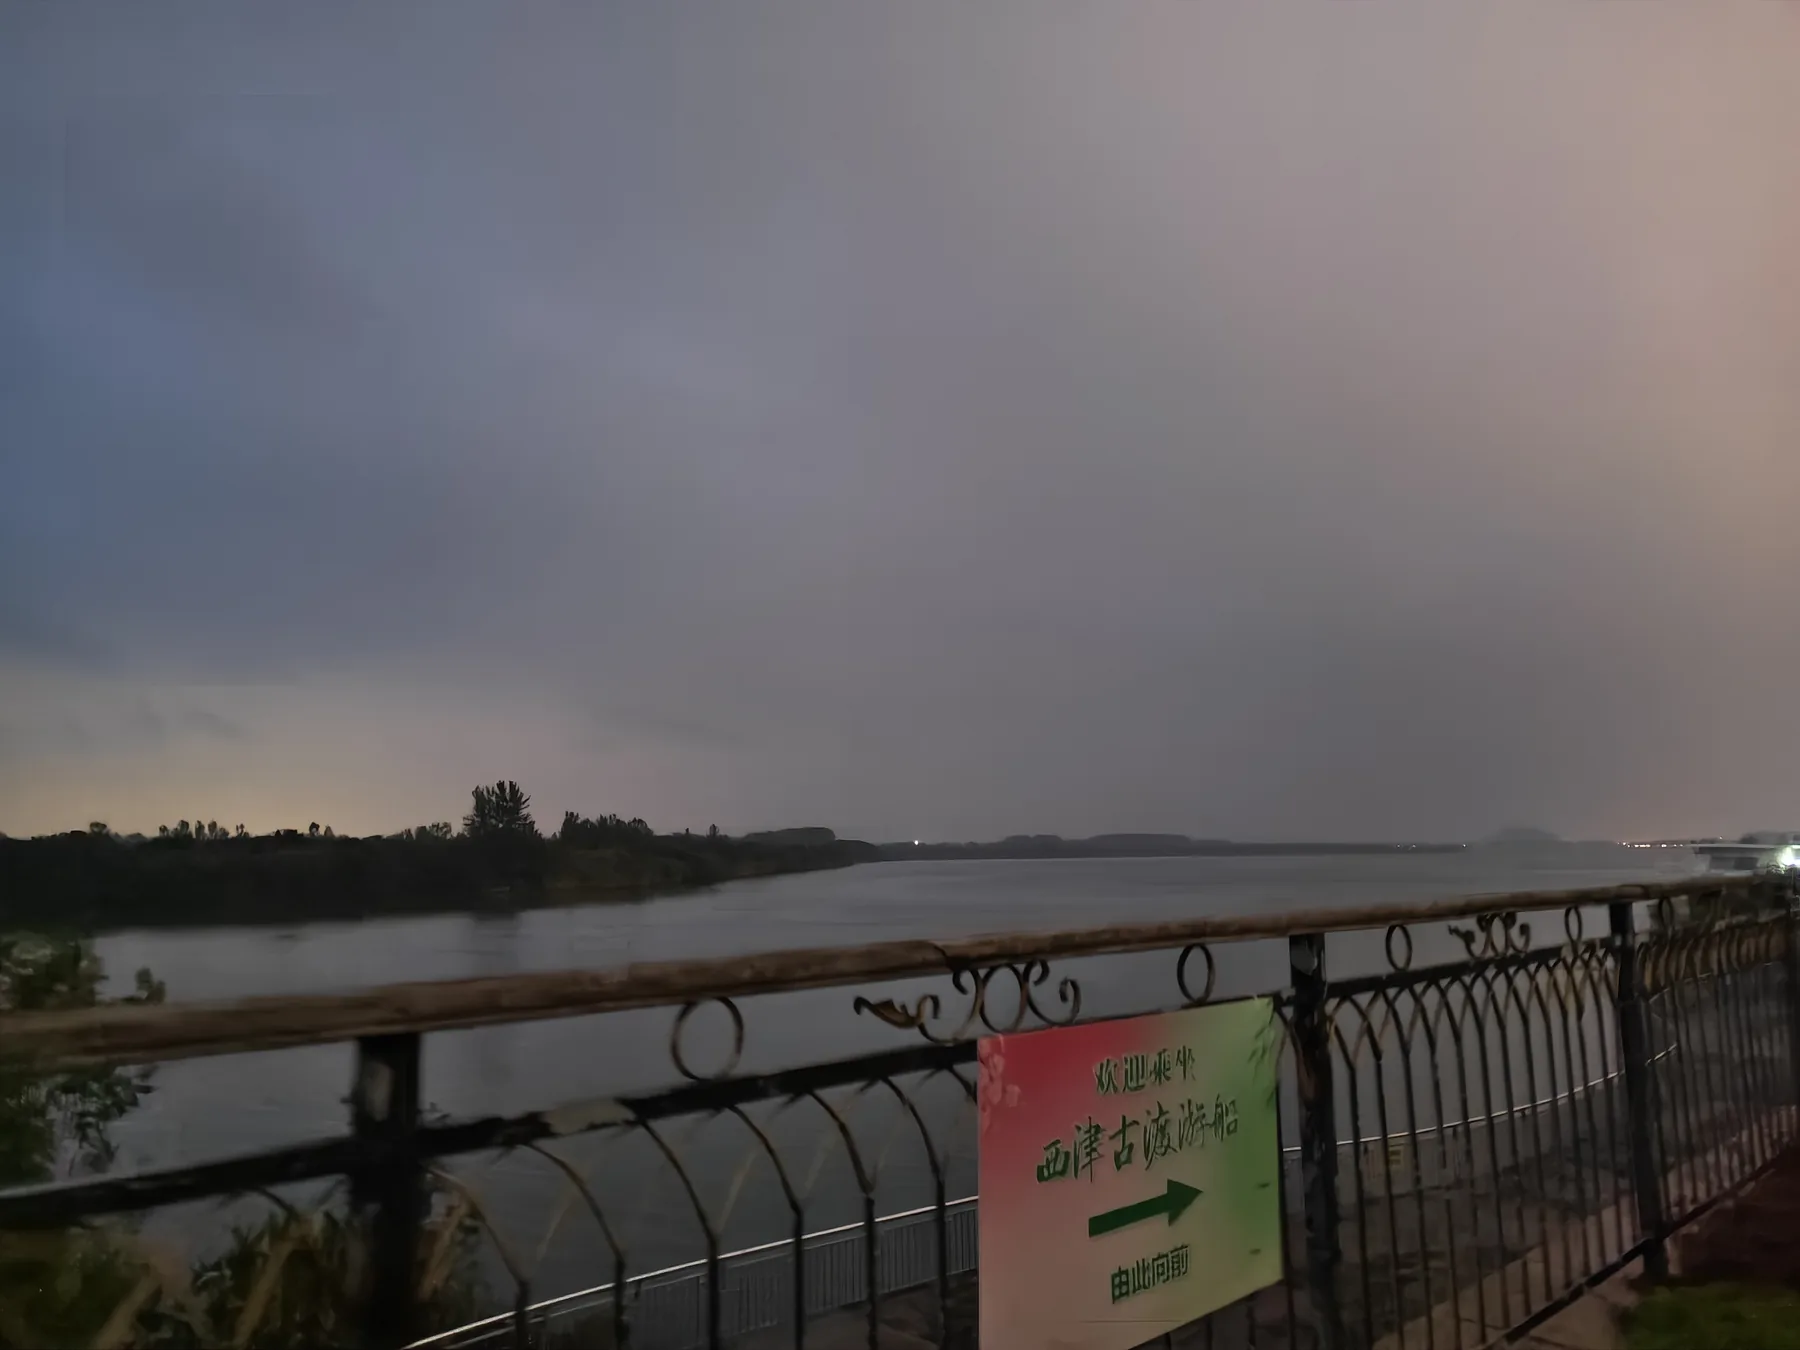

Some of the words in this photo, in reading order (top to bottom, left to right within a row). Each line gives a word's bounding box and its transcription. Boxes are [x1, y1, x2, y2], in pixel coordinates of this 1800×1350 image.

[1036, 1094, 1238, 1183] 西津古渡游船
[1111, 1244, 1189, 1303] 由此向前
